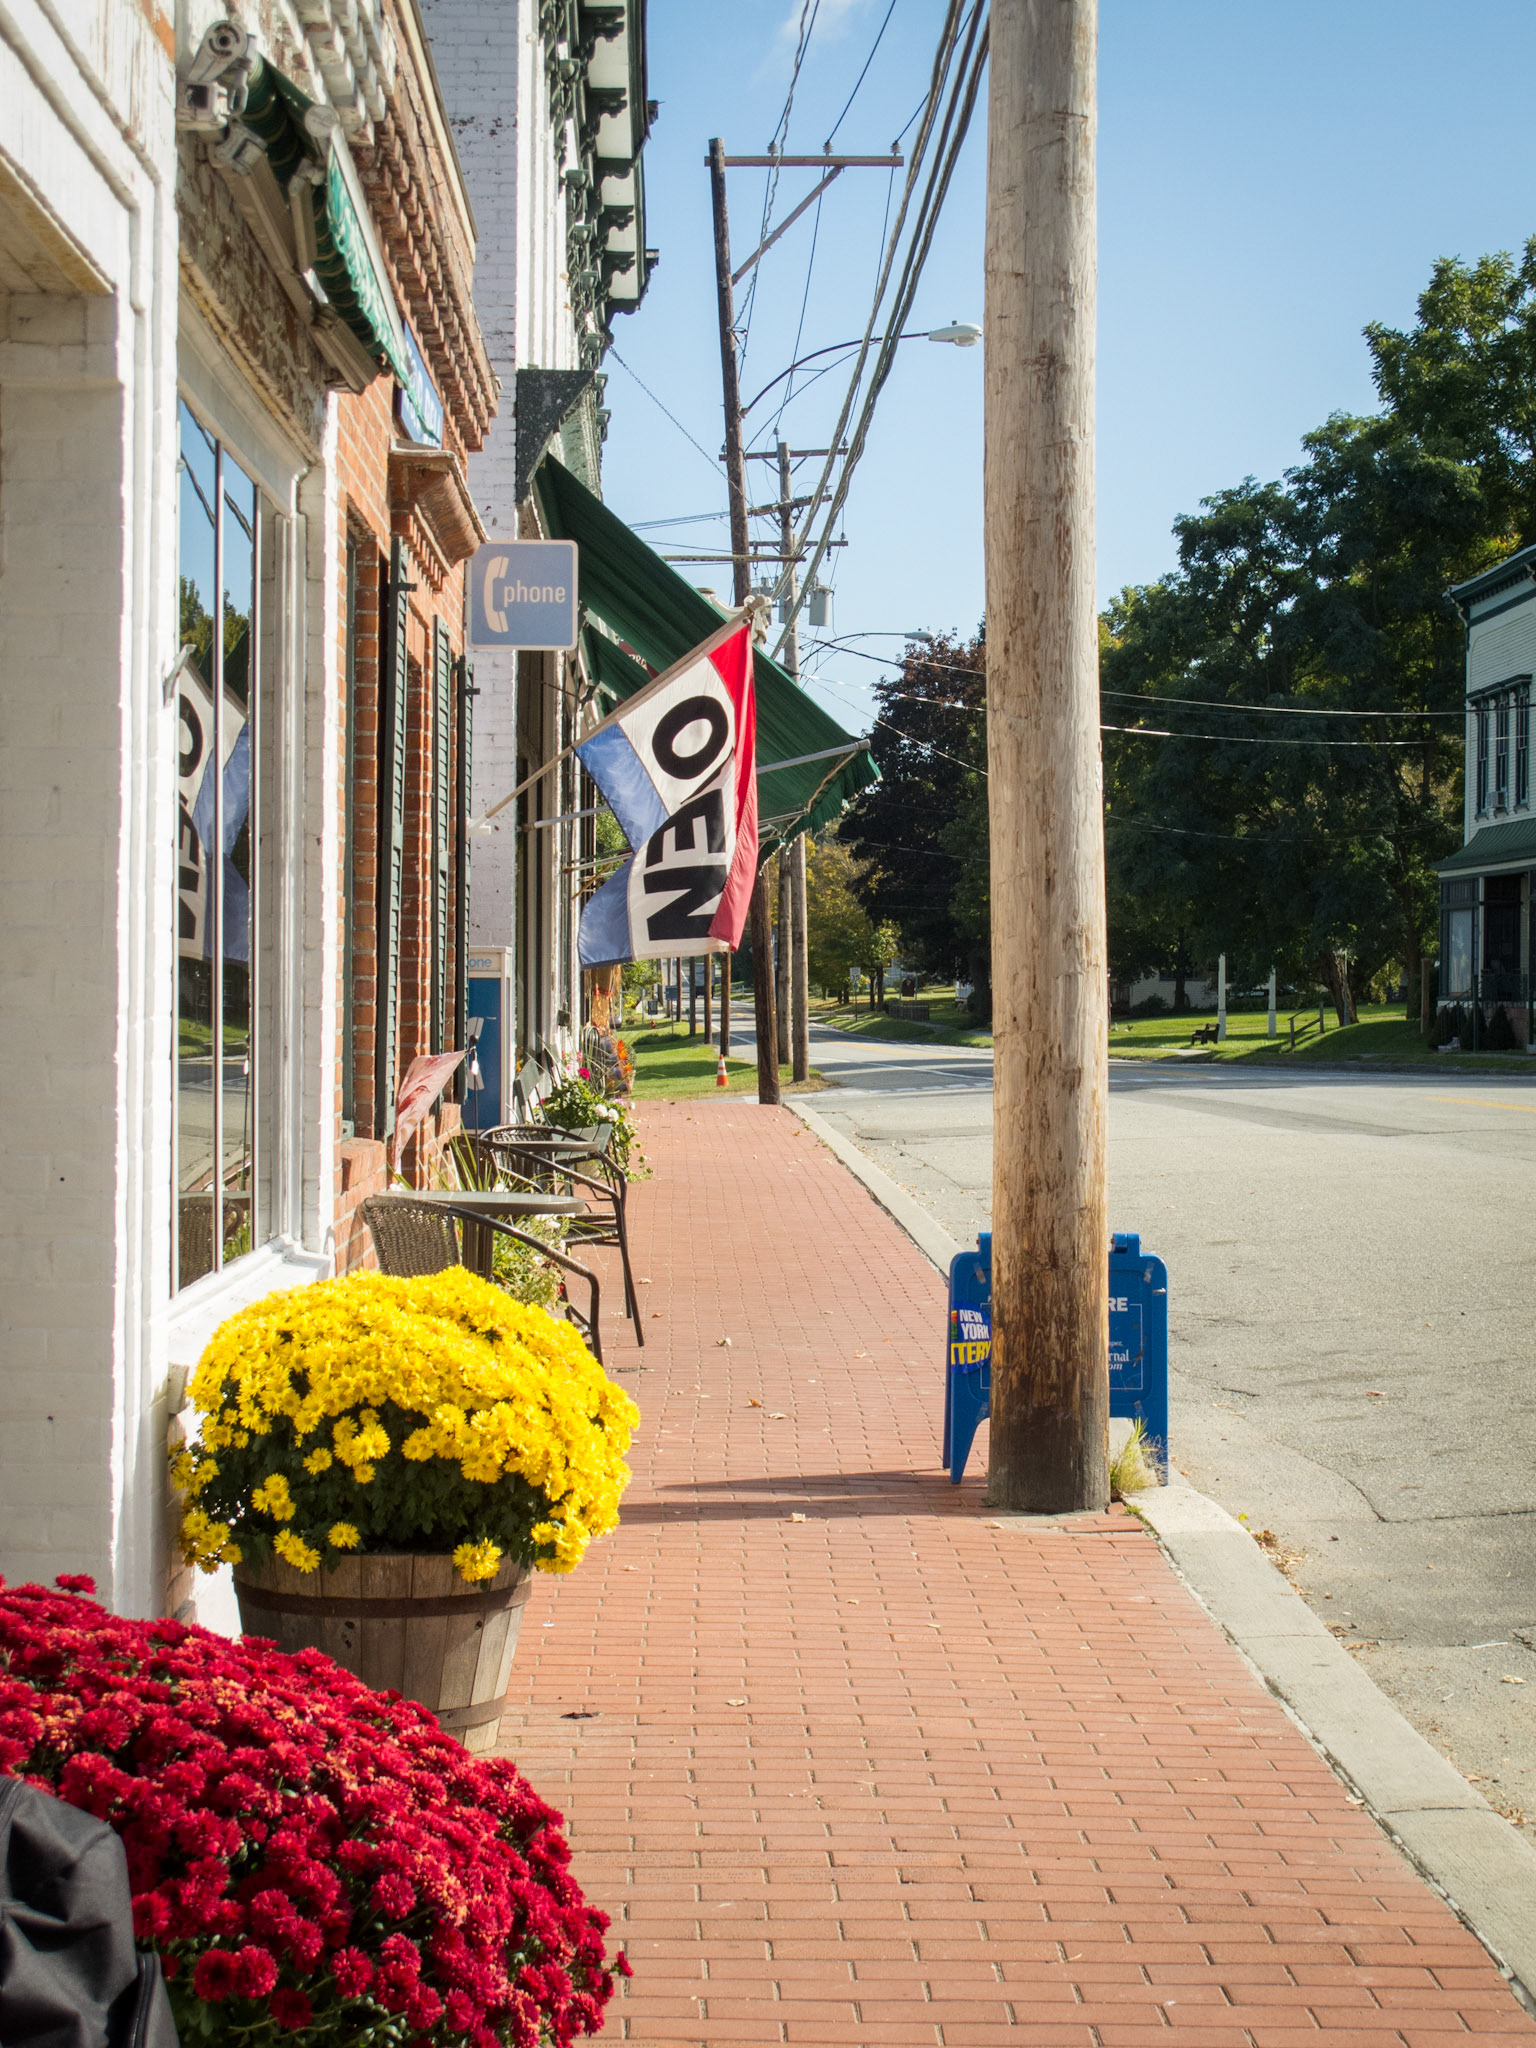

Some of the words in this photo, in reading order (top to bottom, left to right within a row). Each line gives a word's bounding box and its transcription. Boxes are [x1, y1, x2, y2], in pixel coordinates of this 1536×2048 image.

[503, 580, 566, 608] phone
[643, 695, 730, 941] OEN
[959, 1309, 983, 1324] NEW
[960, 1323, 990, 1340] YORK
